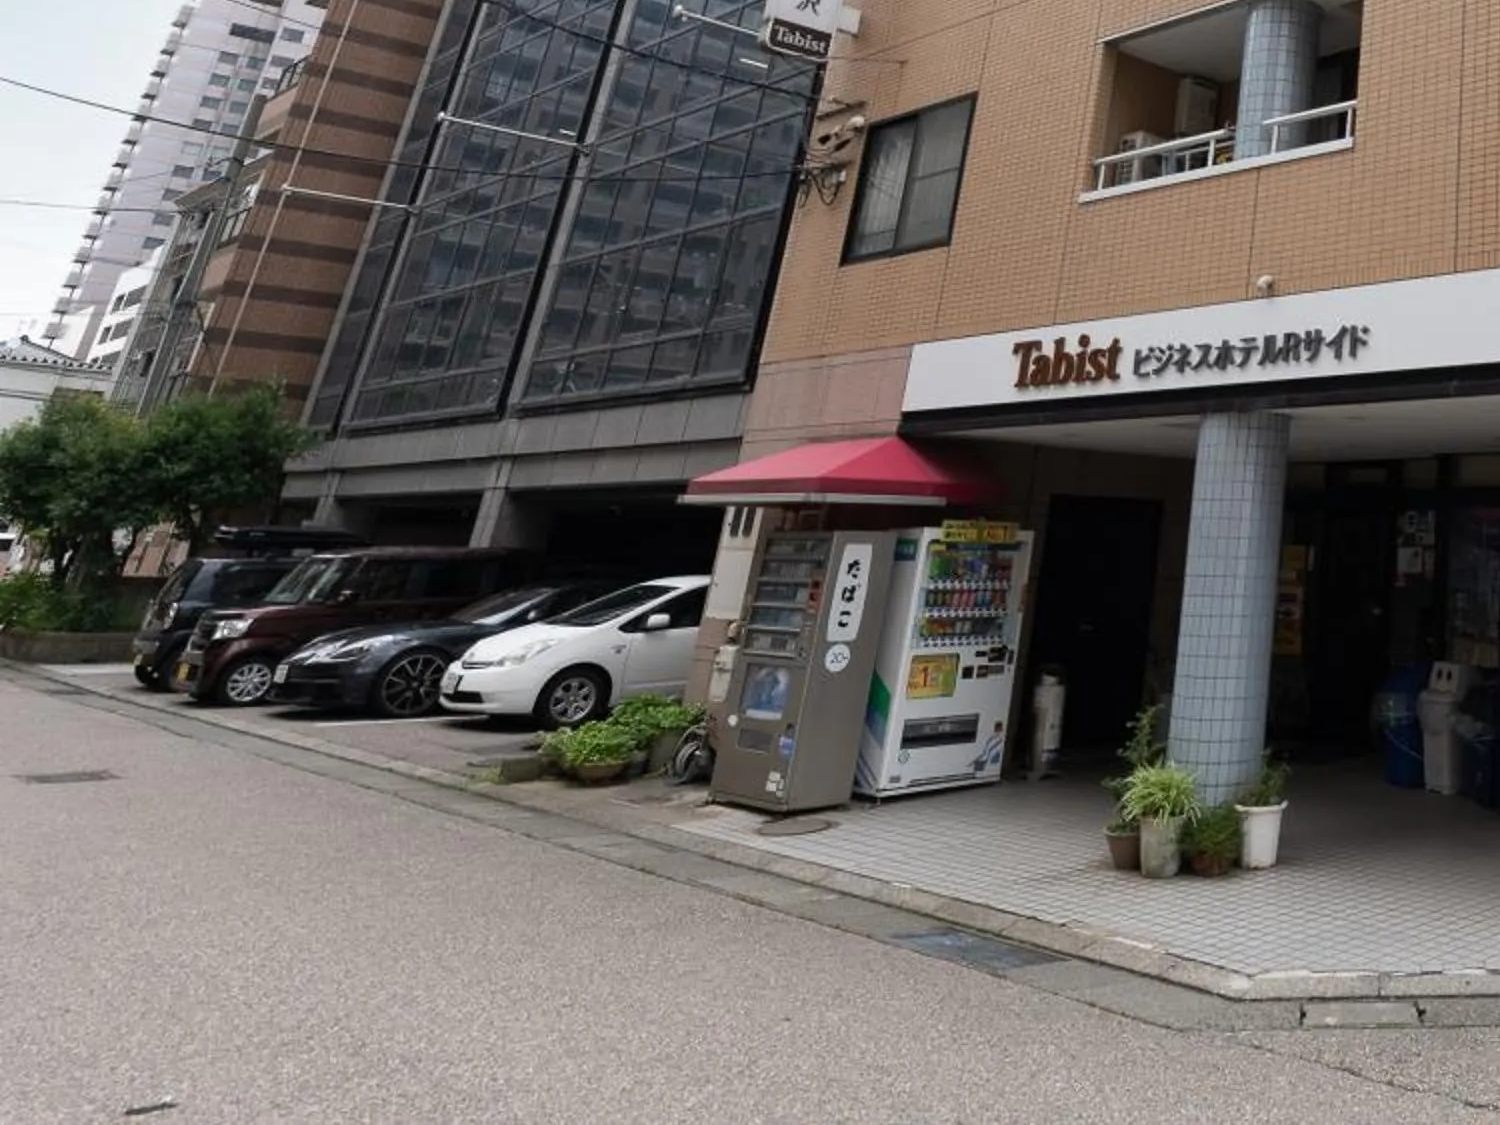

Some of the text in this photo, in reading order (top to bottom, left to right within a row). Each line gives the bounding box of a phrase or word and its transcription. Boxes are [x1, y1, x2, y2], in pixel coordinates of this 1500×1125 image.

[773, 24, 826, 54] Tabist
[1012, 324, 1372, 388] Tabist ビジネスホテルRサイド
[838, 559, 862, 628] たばこ
